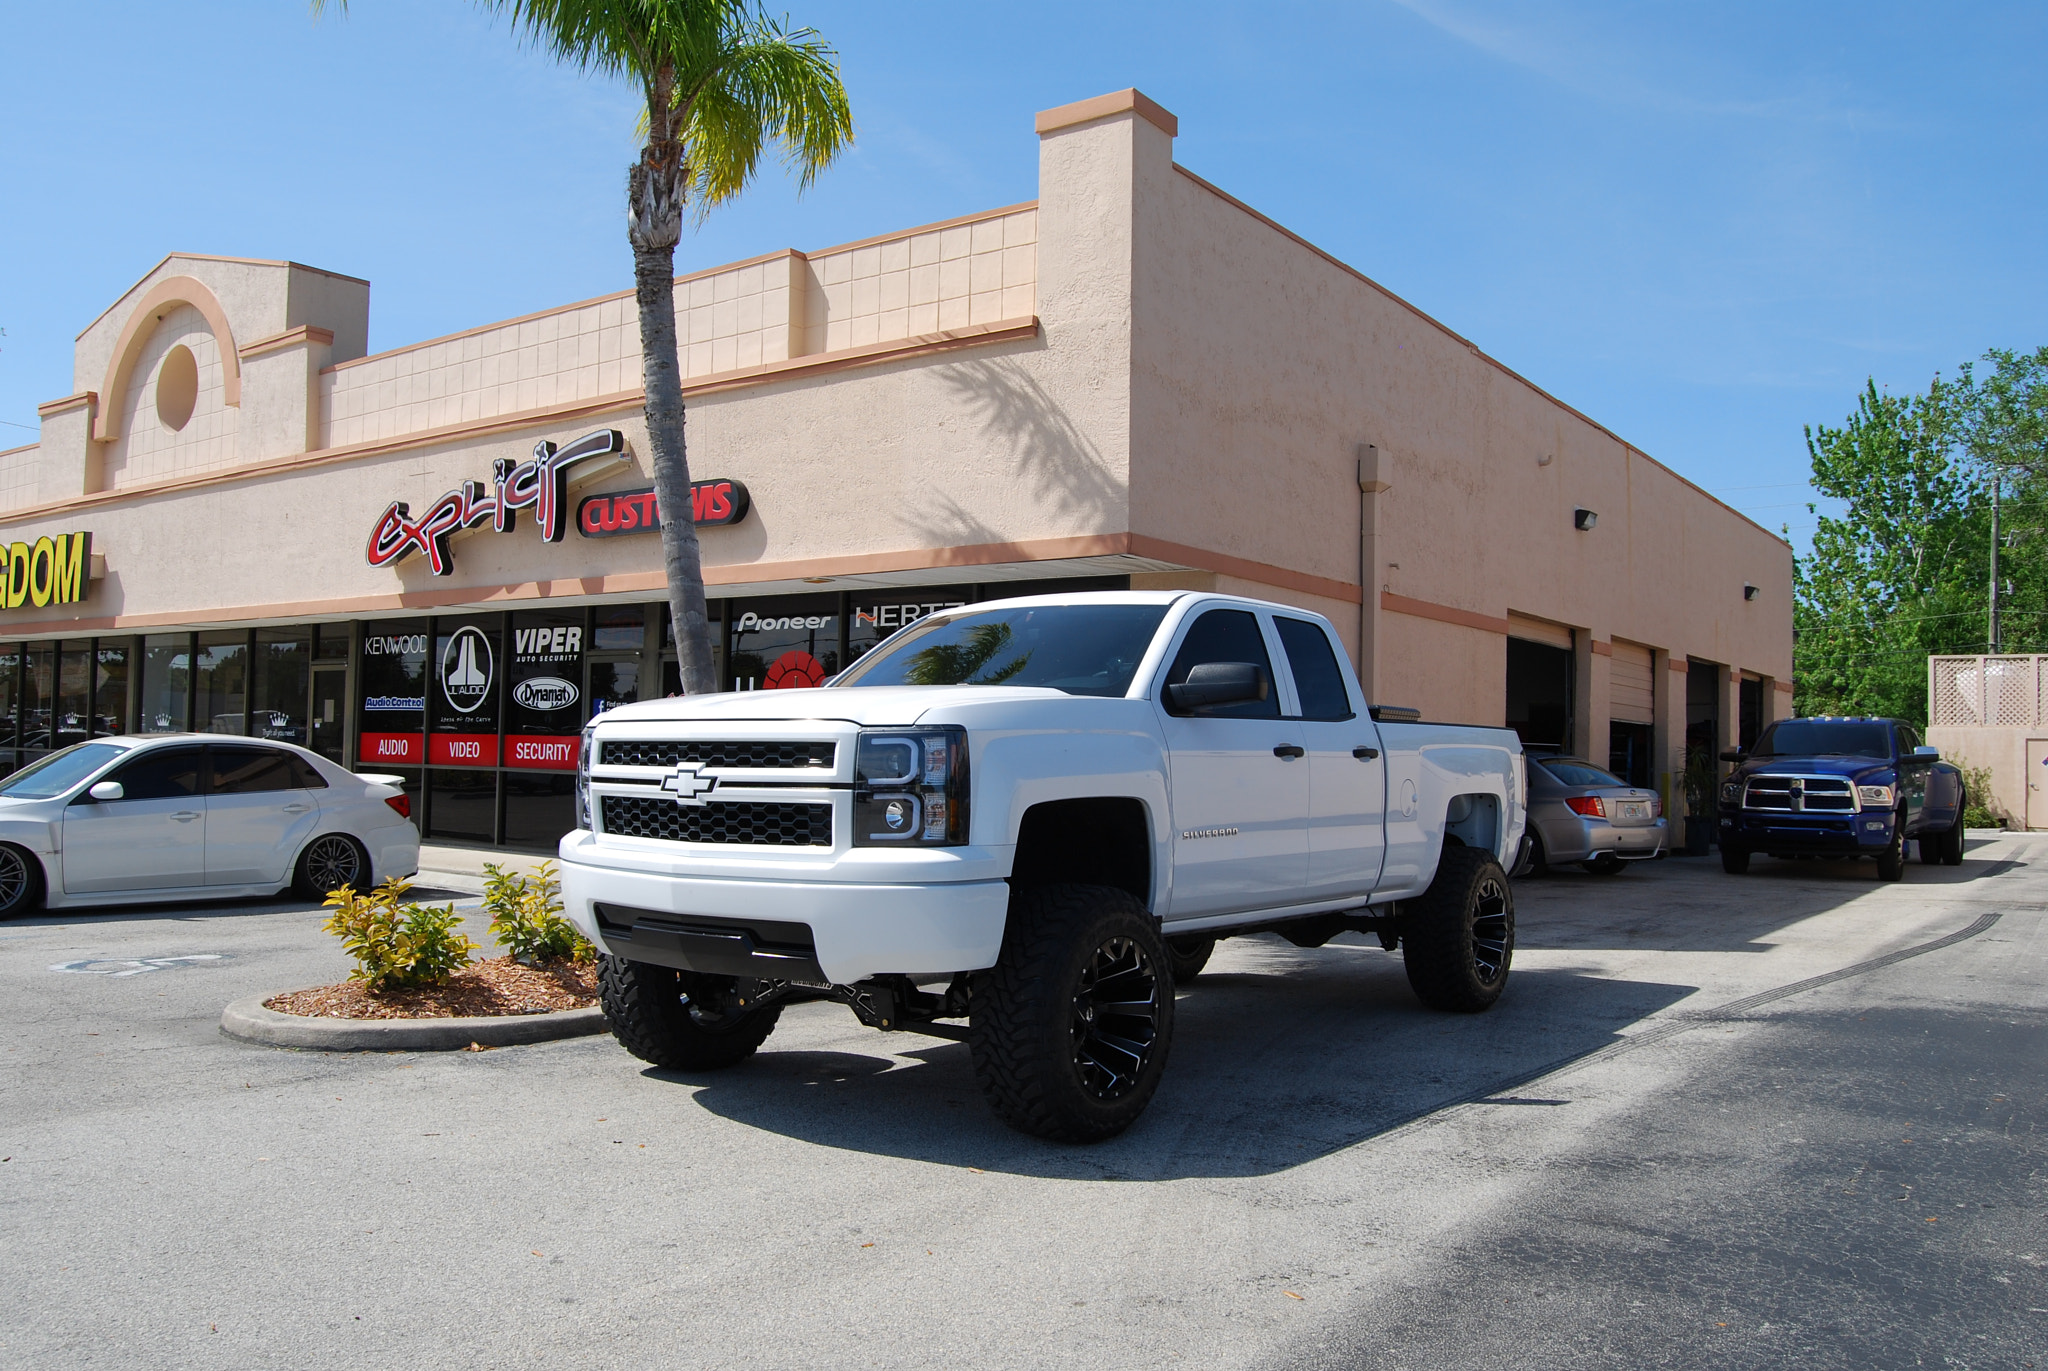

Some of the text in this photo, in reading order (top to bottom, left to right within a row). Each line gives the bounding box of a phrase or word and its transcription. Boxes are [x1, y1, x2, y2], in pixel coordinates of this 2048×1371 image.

[582, 482, 732, 533] CUSTMS
[738, 612, 831, 631] Pioneer
[855, 602, 965, 628] HERT
[365, 634, 428, 655] KENWOOD
[515, 626, 582, 654] VIPER
[539, 654, 578, 662] SECURITY
[458, 685, 485, 695] AUDIO
[524, 683, 567, 706] Dynamat
[365, 696, 425, 707] AudioControl
[378, 739, 408, 756] AUDIO
[449, 741, 480, 758] VIDEO
[516, 743, 571, 761] SECURITY
[1182, 827, 1239, 840] SILVERADO
